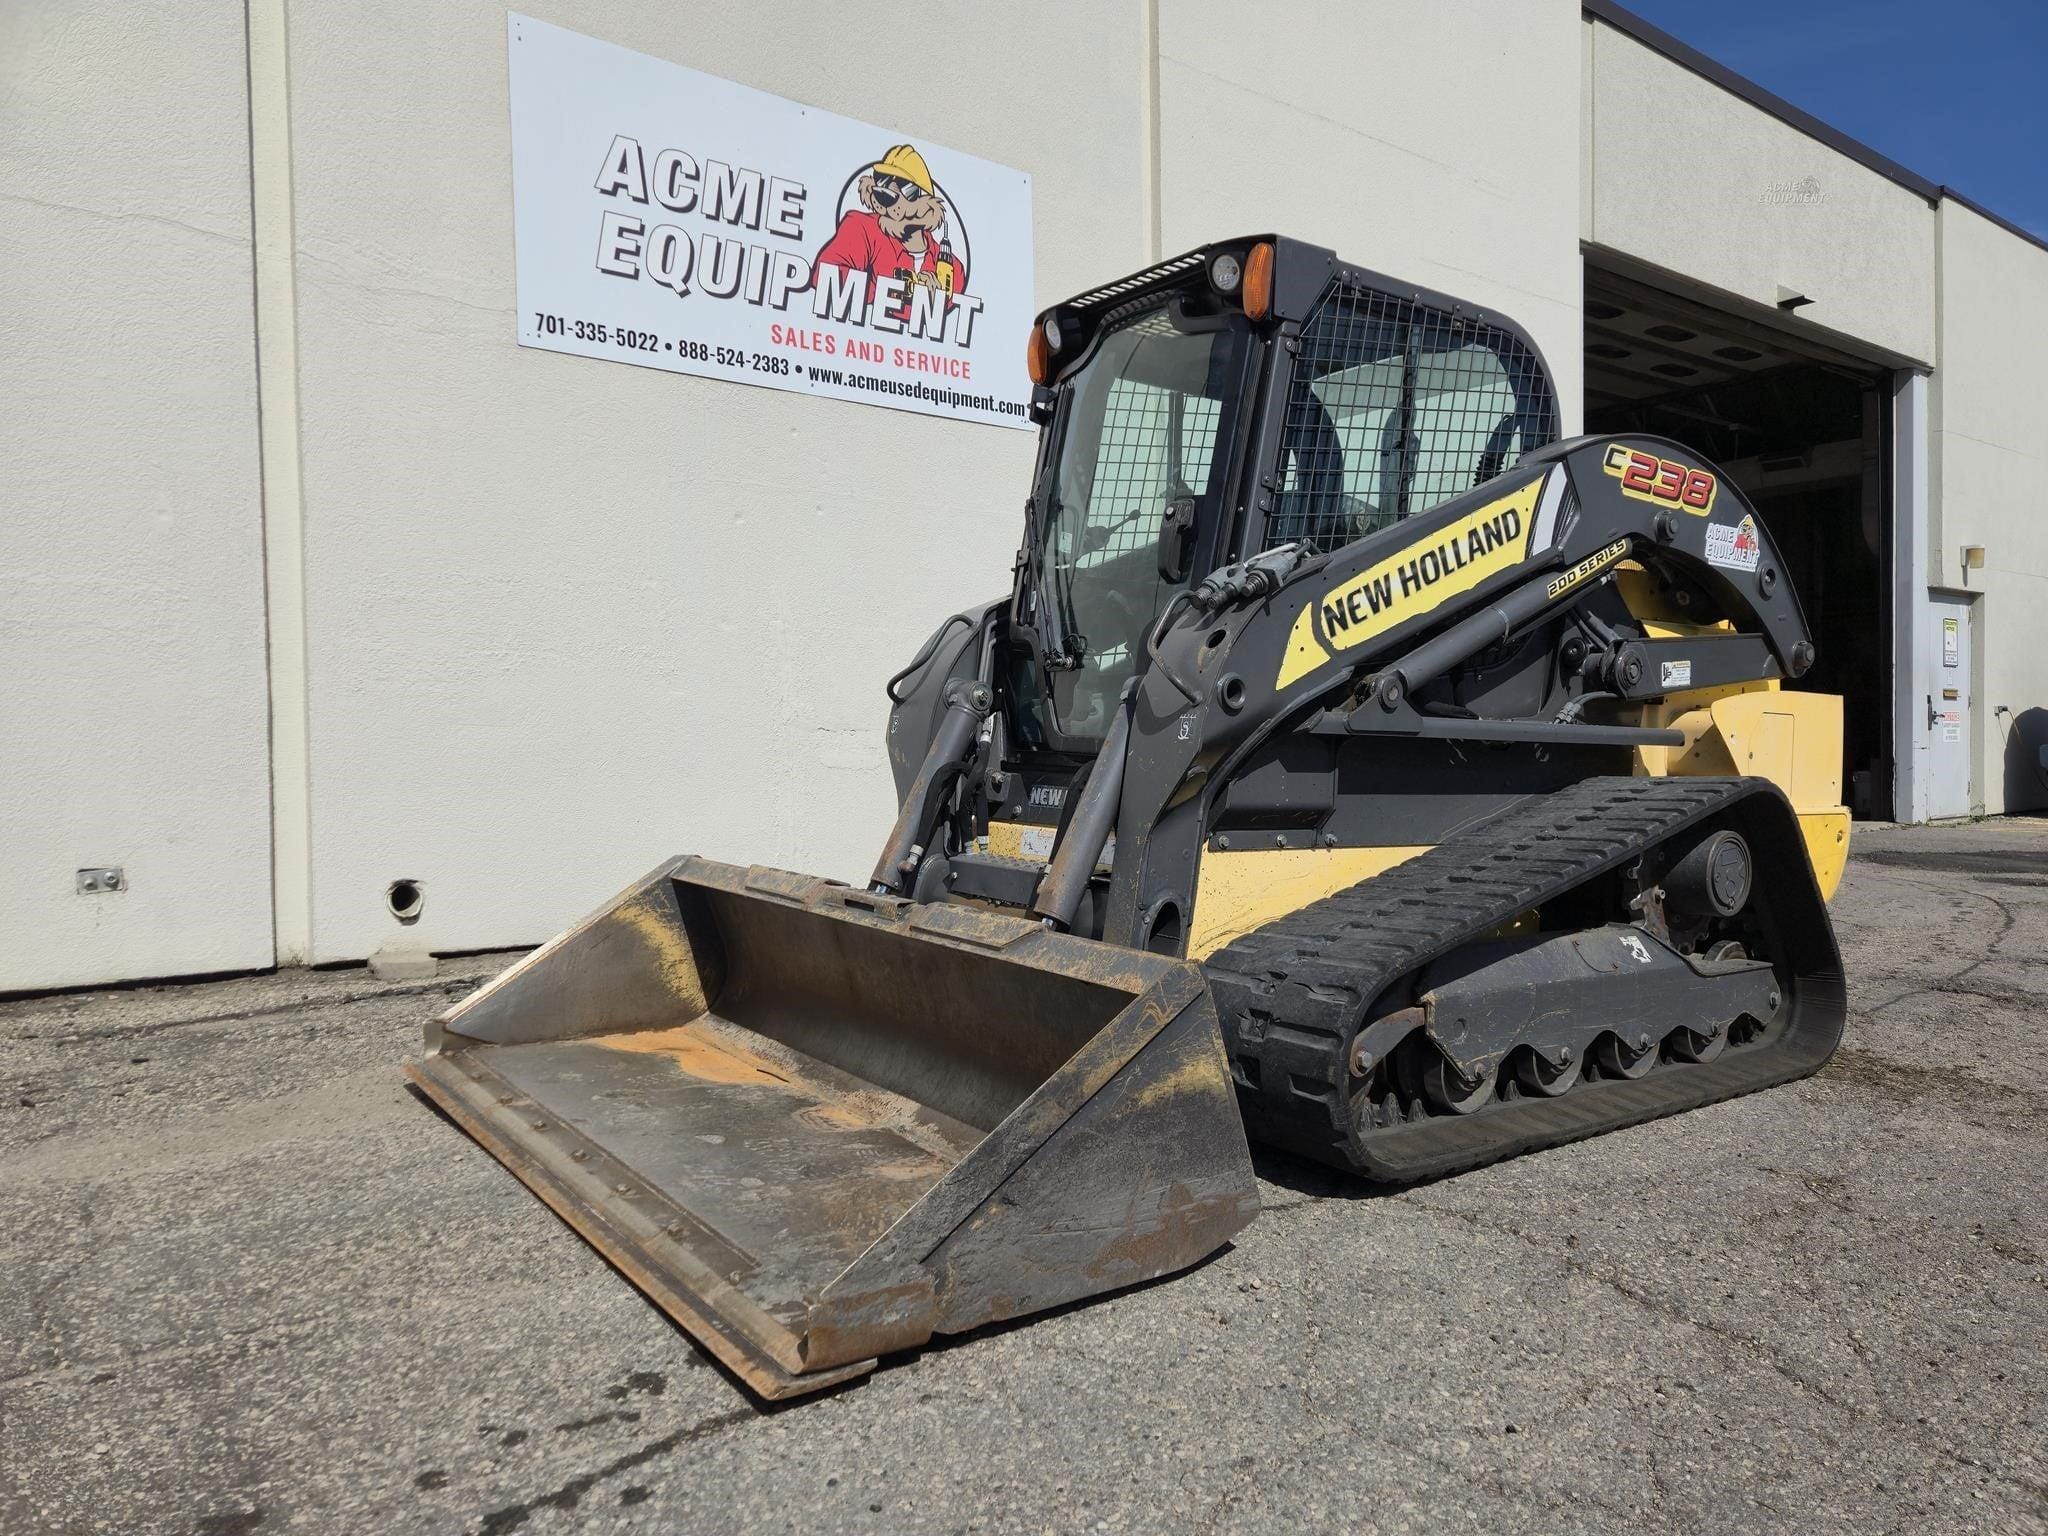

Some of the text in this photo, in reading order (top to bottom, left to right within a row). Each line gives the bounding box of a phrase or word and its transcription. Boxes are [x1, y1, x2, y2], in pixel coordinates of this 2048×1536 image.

[594, 134, 806, 240] ACME
[596, 210, 983, 348] EQUIPMENT
[535, 312, 1026, 417] 701-335-5022 888-524-2383 www.acmeusedequipment.com
[771, 323, 971, 380] SALES AND SERVICE
[1605, 448, 1715, 509] C238
[1706, 543, 1760, 565] EQUIPMENT
[1707, 524, 1734, 543] ACME
[1322, 507, 1521, 638] NEW HOLLAND
[1548, 540, 1625, 596] 200 SERIES
[1030, 787, 1062, 806] NEW
